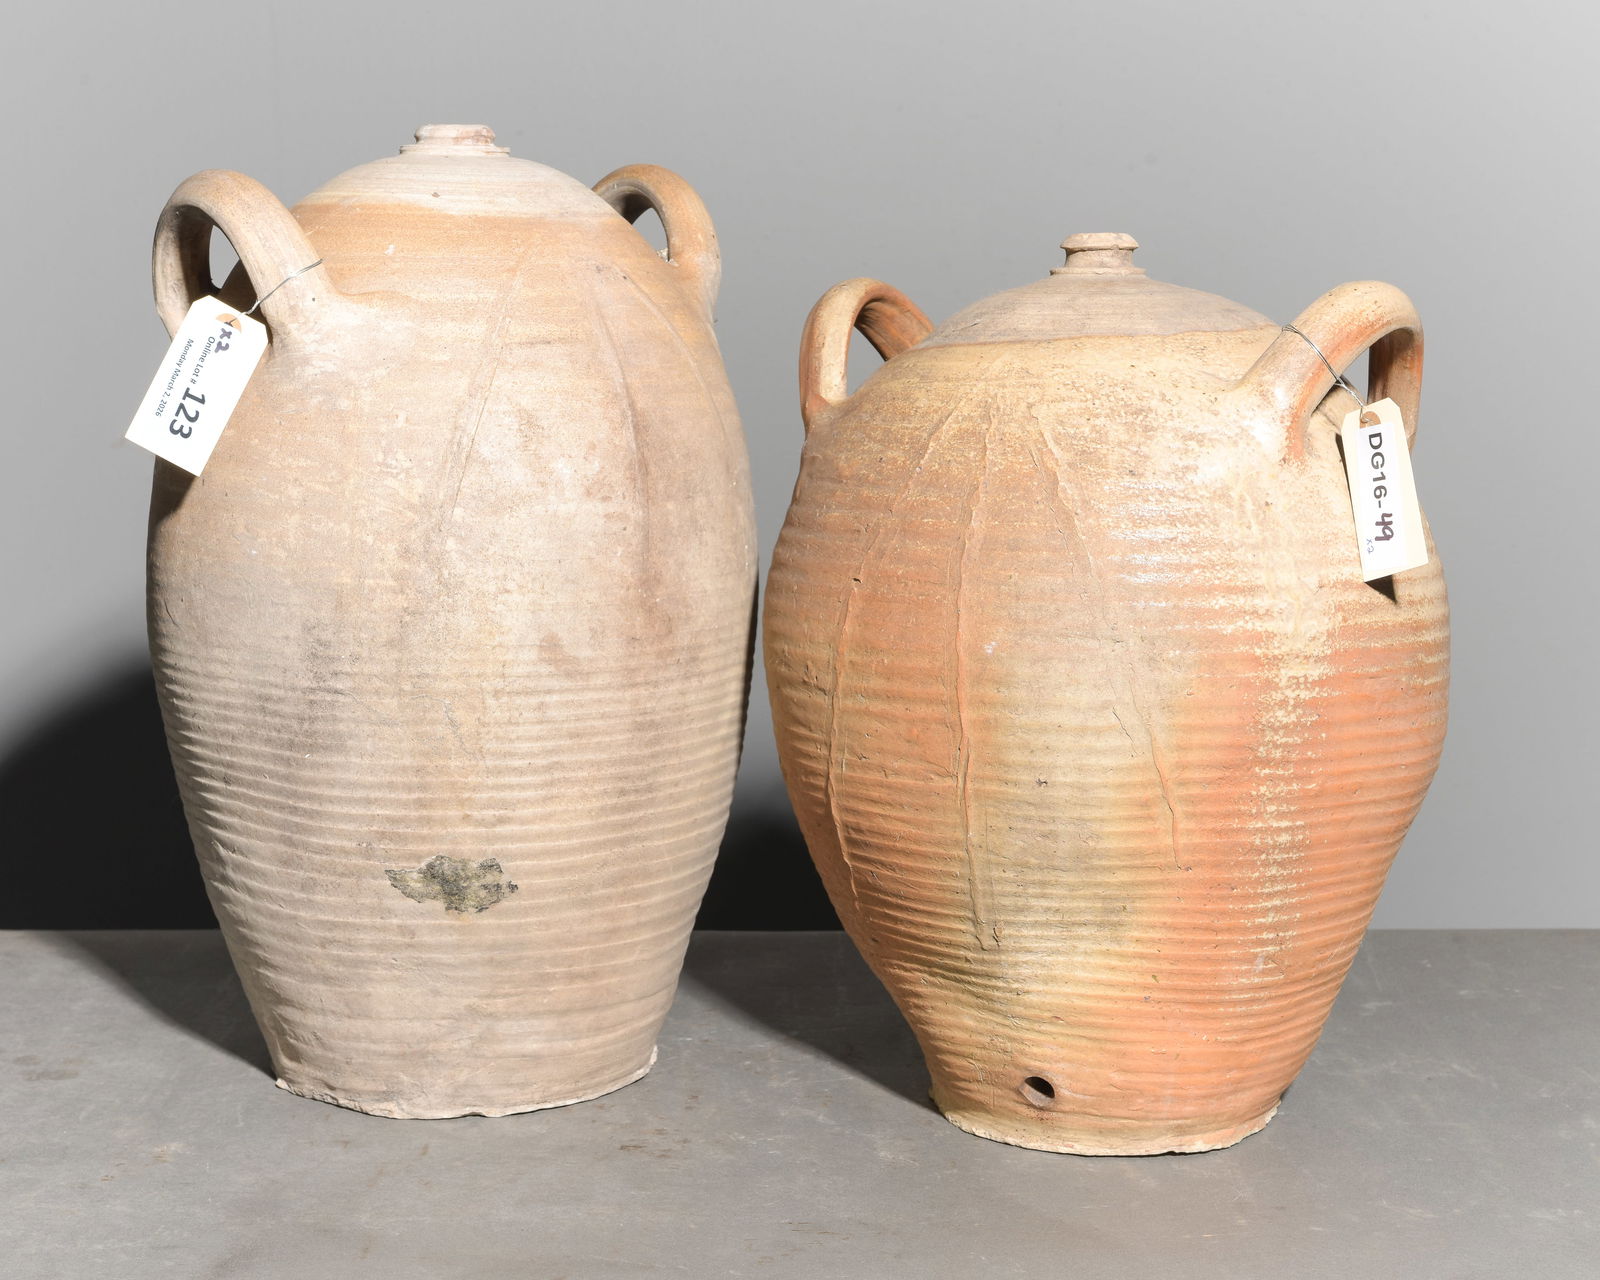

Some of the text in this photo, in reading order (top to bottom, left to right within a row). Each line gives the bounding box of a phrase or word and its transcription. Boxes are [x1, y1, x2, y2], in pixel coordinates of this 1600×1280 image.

[176, 338, 194, 369] Monday
[198, 336, 216, 363] Online
[166, 368, 181, 391] March
[192, 363, 204, 377] Lot
[155, 398, 168, 417] 2026
[169, 387, 206, 439] 123
[1368, 432, 1394, 541] DG16-49
